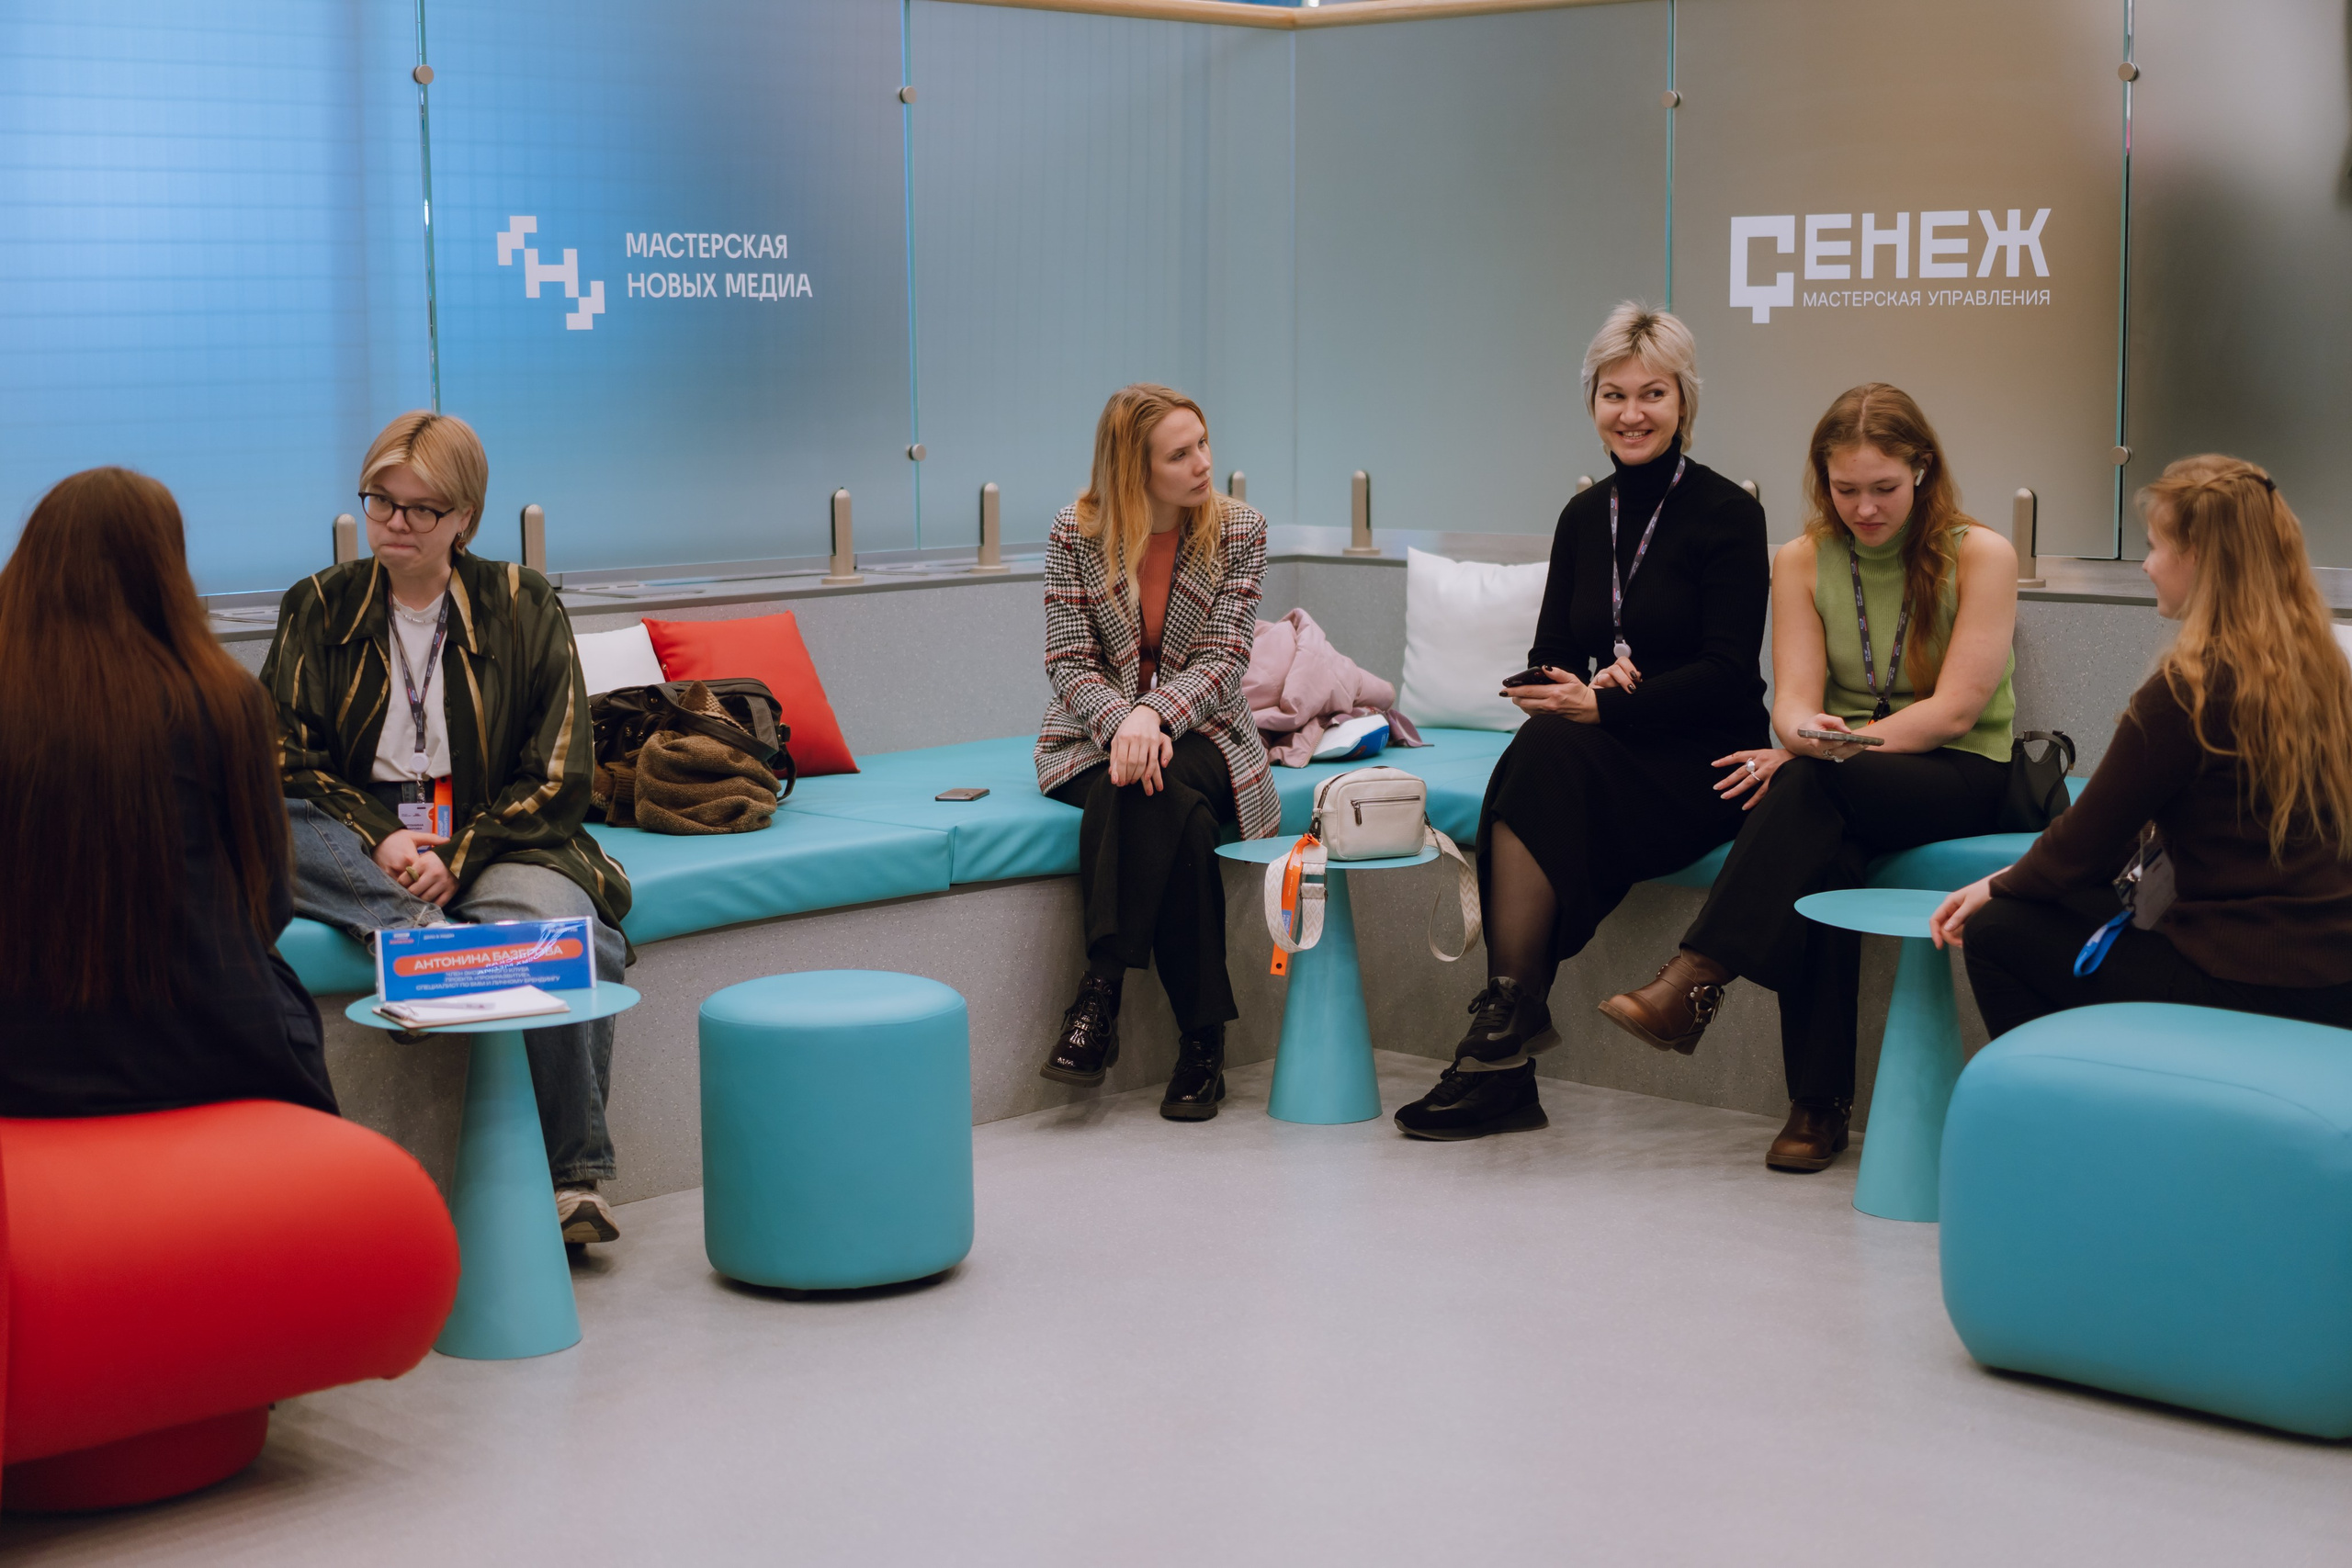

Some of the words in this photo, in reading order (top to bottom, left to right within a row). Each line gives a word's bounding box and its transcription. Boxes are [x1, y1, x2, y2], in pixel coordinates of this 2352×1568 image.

[626, 232, 788, 259] МАСТЕРСКАЯ
[1729, 208, 2052, 324] СЕНЕЖ
[628, 273, 718, 299] НОВЫХ
[725, 273, 813, 302] МЕДИА
[1803, 290, 1921, 307] МАСТЕРСКАЯ
[1928, 289, 2051, 306] УПРАВЛЕНИЯ
[414, 953, 491, 971] АНТОНИНА
